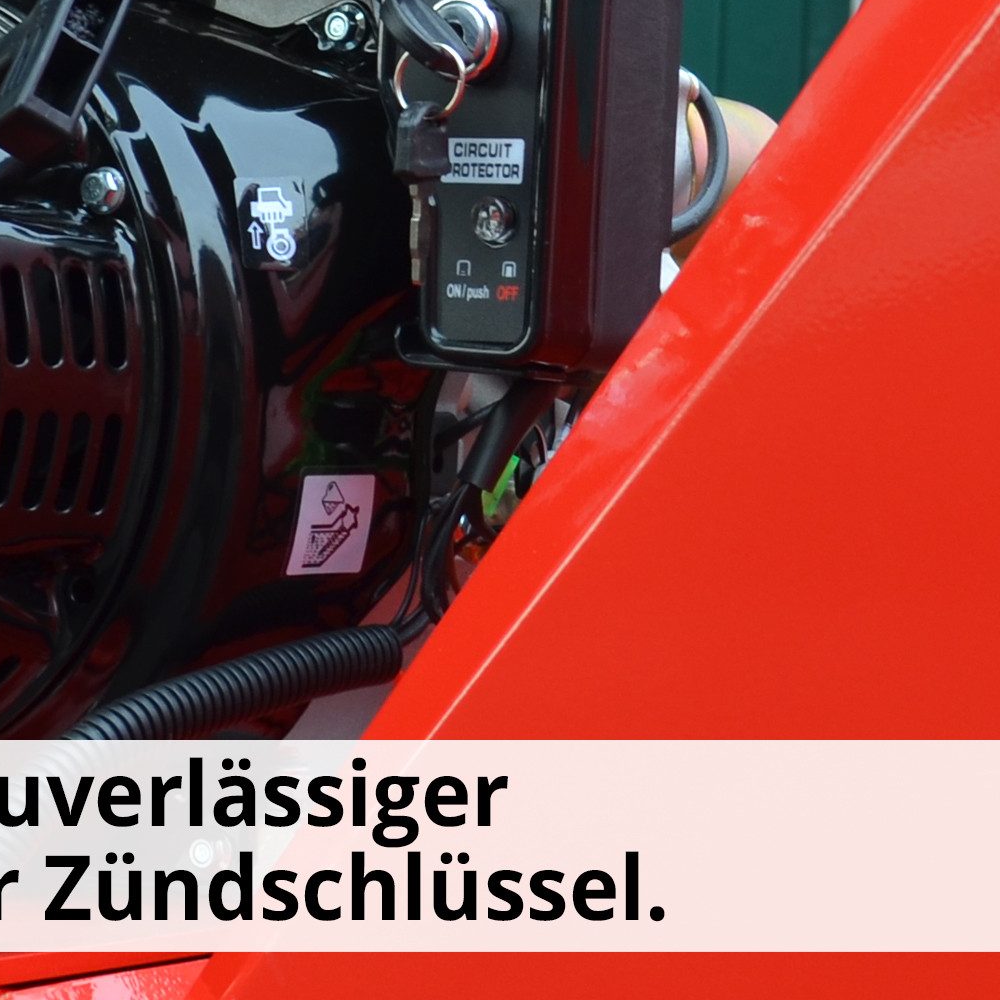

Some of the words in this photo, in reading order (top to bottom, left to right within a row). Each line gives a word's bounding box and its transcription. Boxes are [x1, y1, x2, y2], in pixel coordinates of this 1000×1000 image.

[454, 142, 512, 158] CIRCUIT
[452, 163, 520, 178] ROTECTOR
[496, 285, 520, 302] OFF
